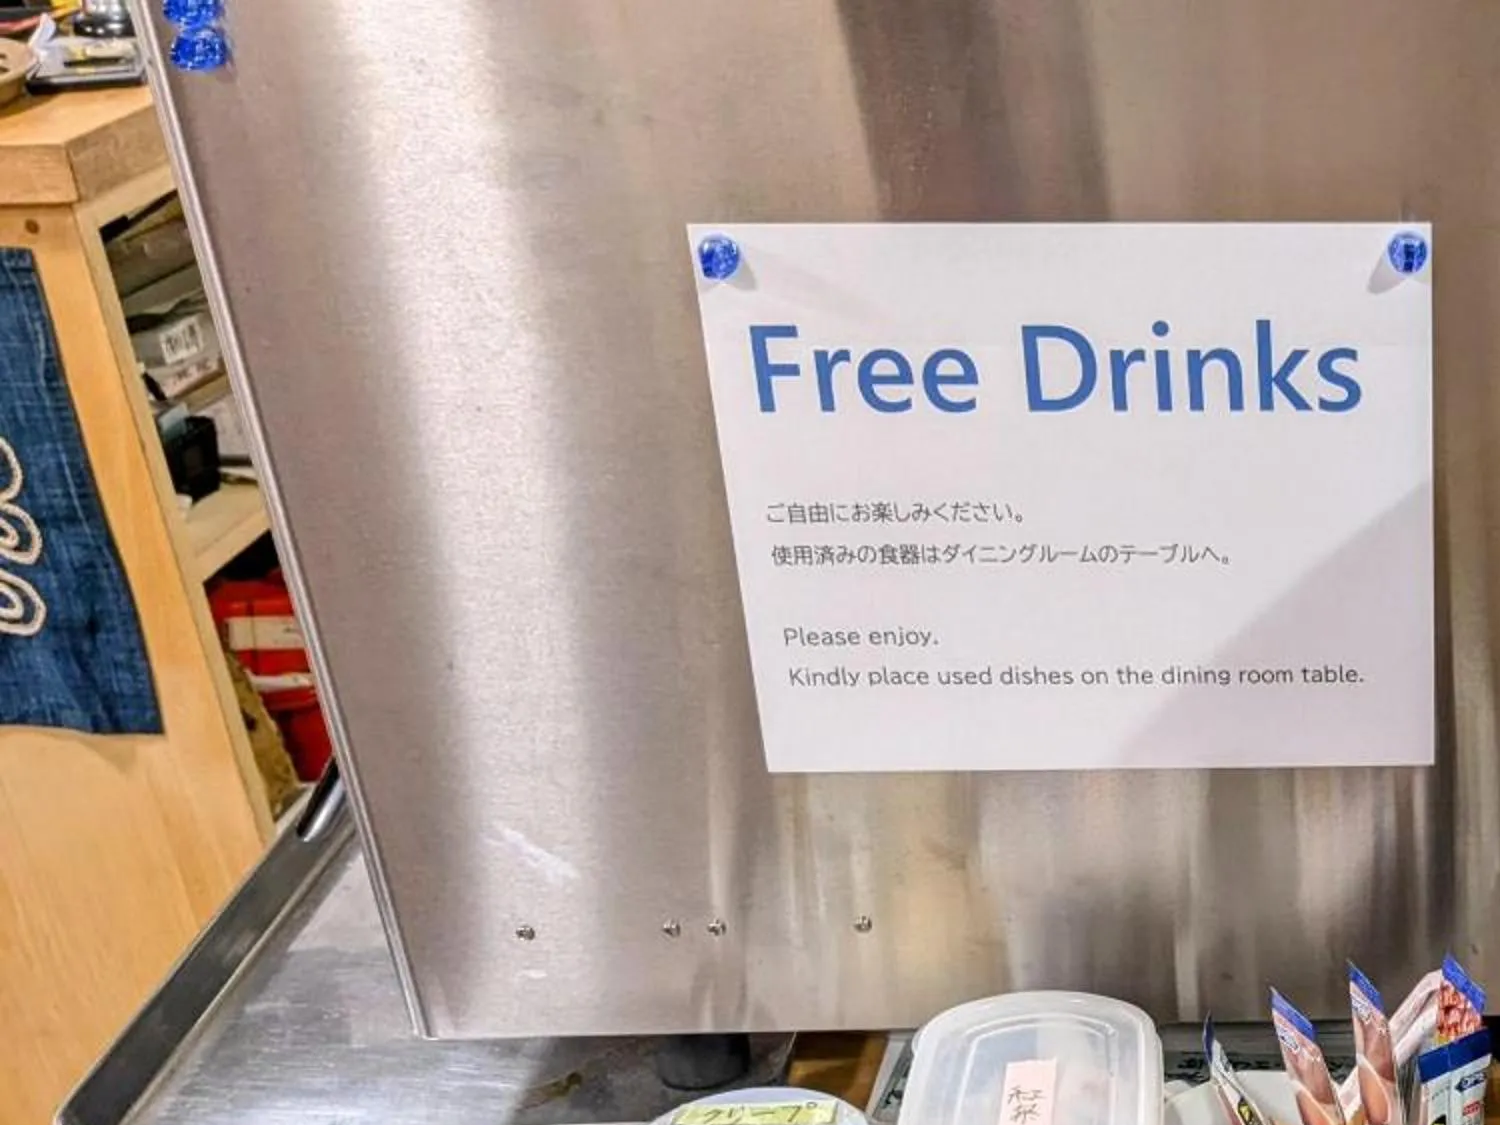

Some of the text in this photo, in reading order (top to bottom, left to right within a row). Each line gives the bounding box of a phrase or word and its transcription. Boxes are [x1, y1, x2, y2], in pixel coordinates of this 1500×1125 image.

[749, 319, 1363, 413] Free Drinks
[767, 502, 1023, 523] ご自由にお楽しみください。
[771, 544, 1229, 566] 使用済みの食器はダイニングルームのテーブルへ。
[784, 627, 940, 647] Please enjoy.
[789, 663, 1365, 687] Kindly place used dishes on the dining room table.
[704, 1101, 818, 1125] クリープ
